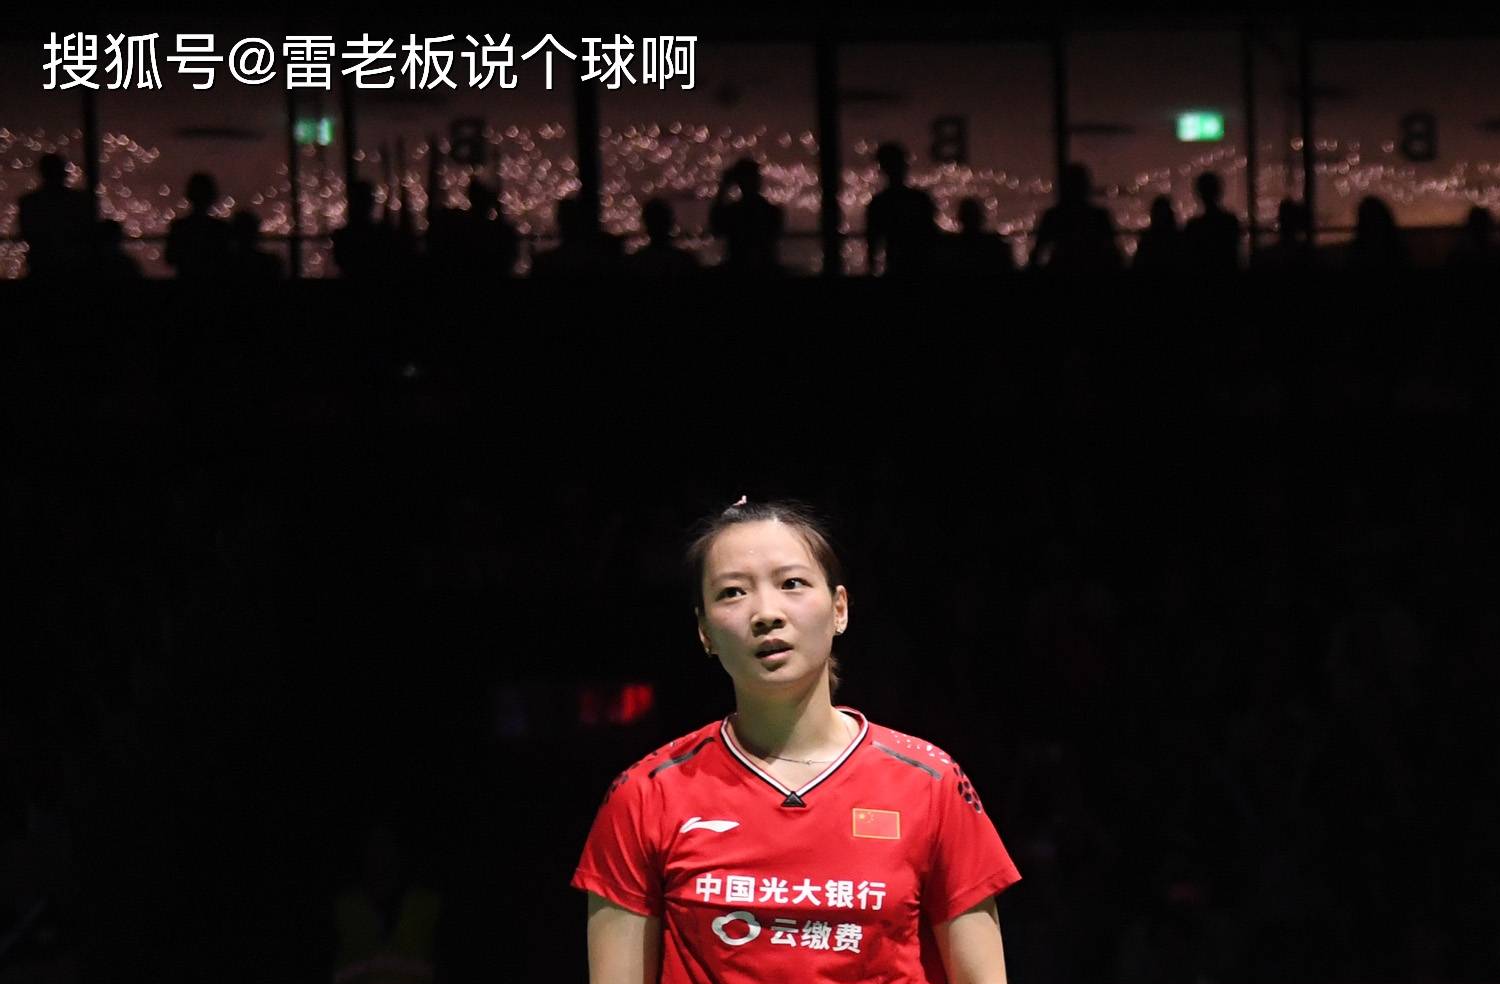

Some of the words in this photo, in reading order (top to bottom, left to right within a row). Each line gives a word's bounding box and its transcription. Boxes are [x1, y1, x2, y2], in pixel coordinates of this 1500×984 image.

[695, 872, 887, 911] 中国光大银行
[769, 917, 863, 954] 云缴费
